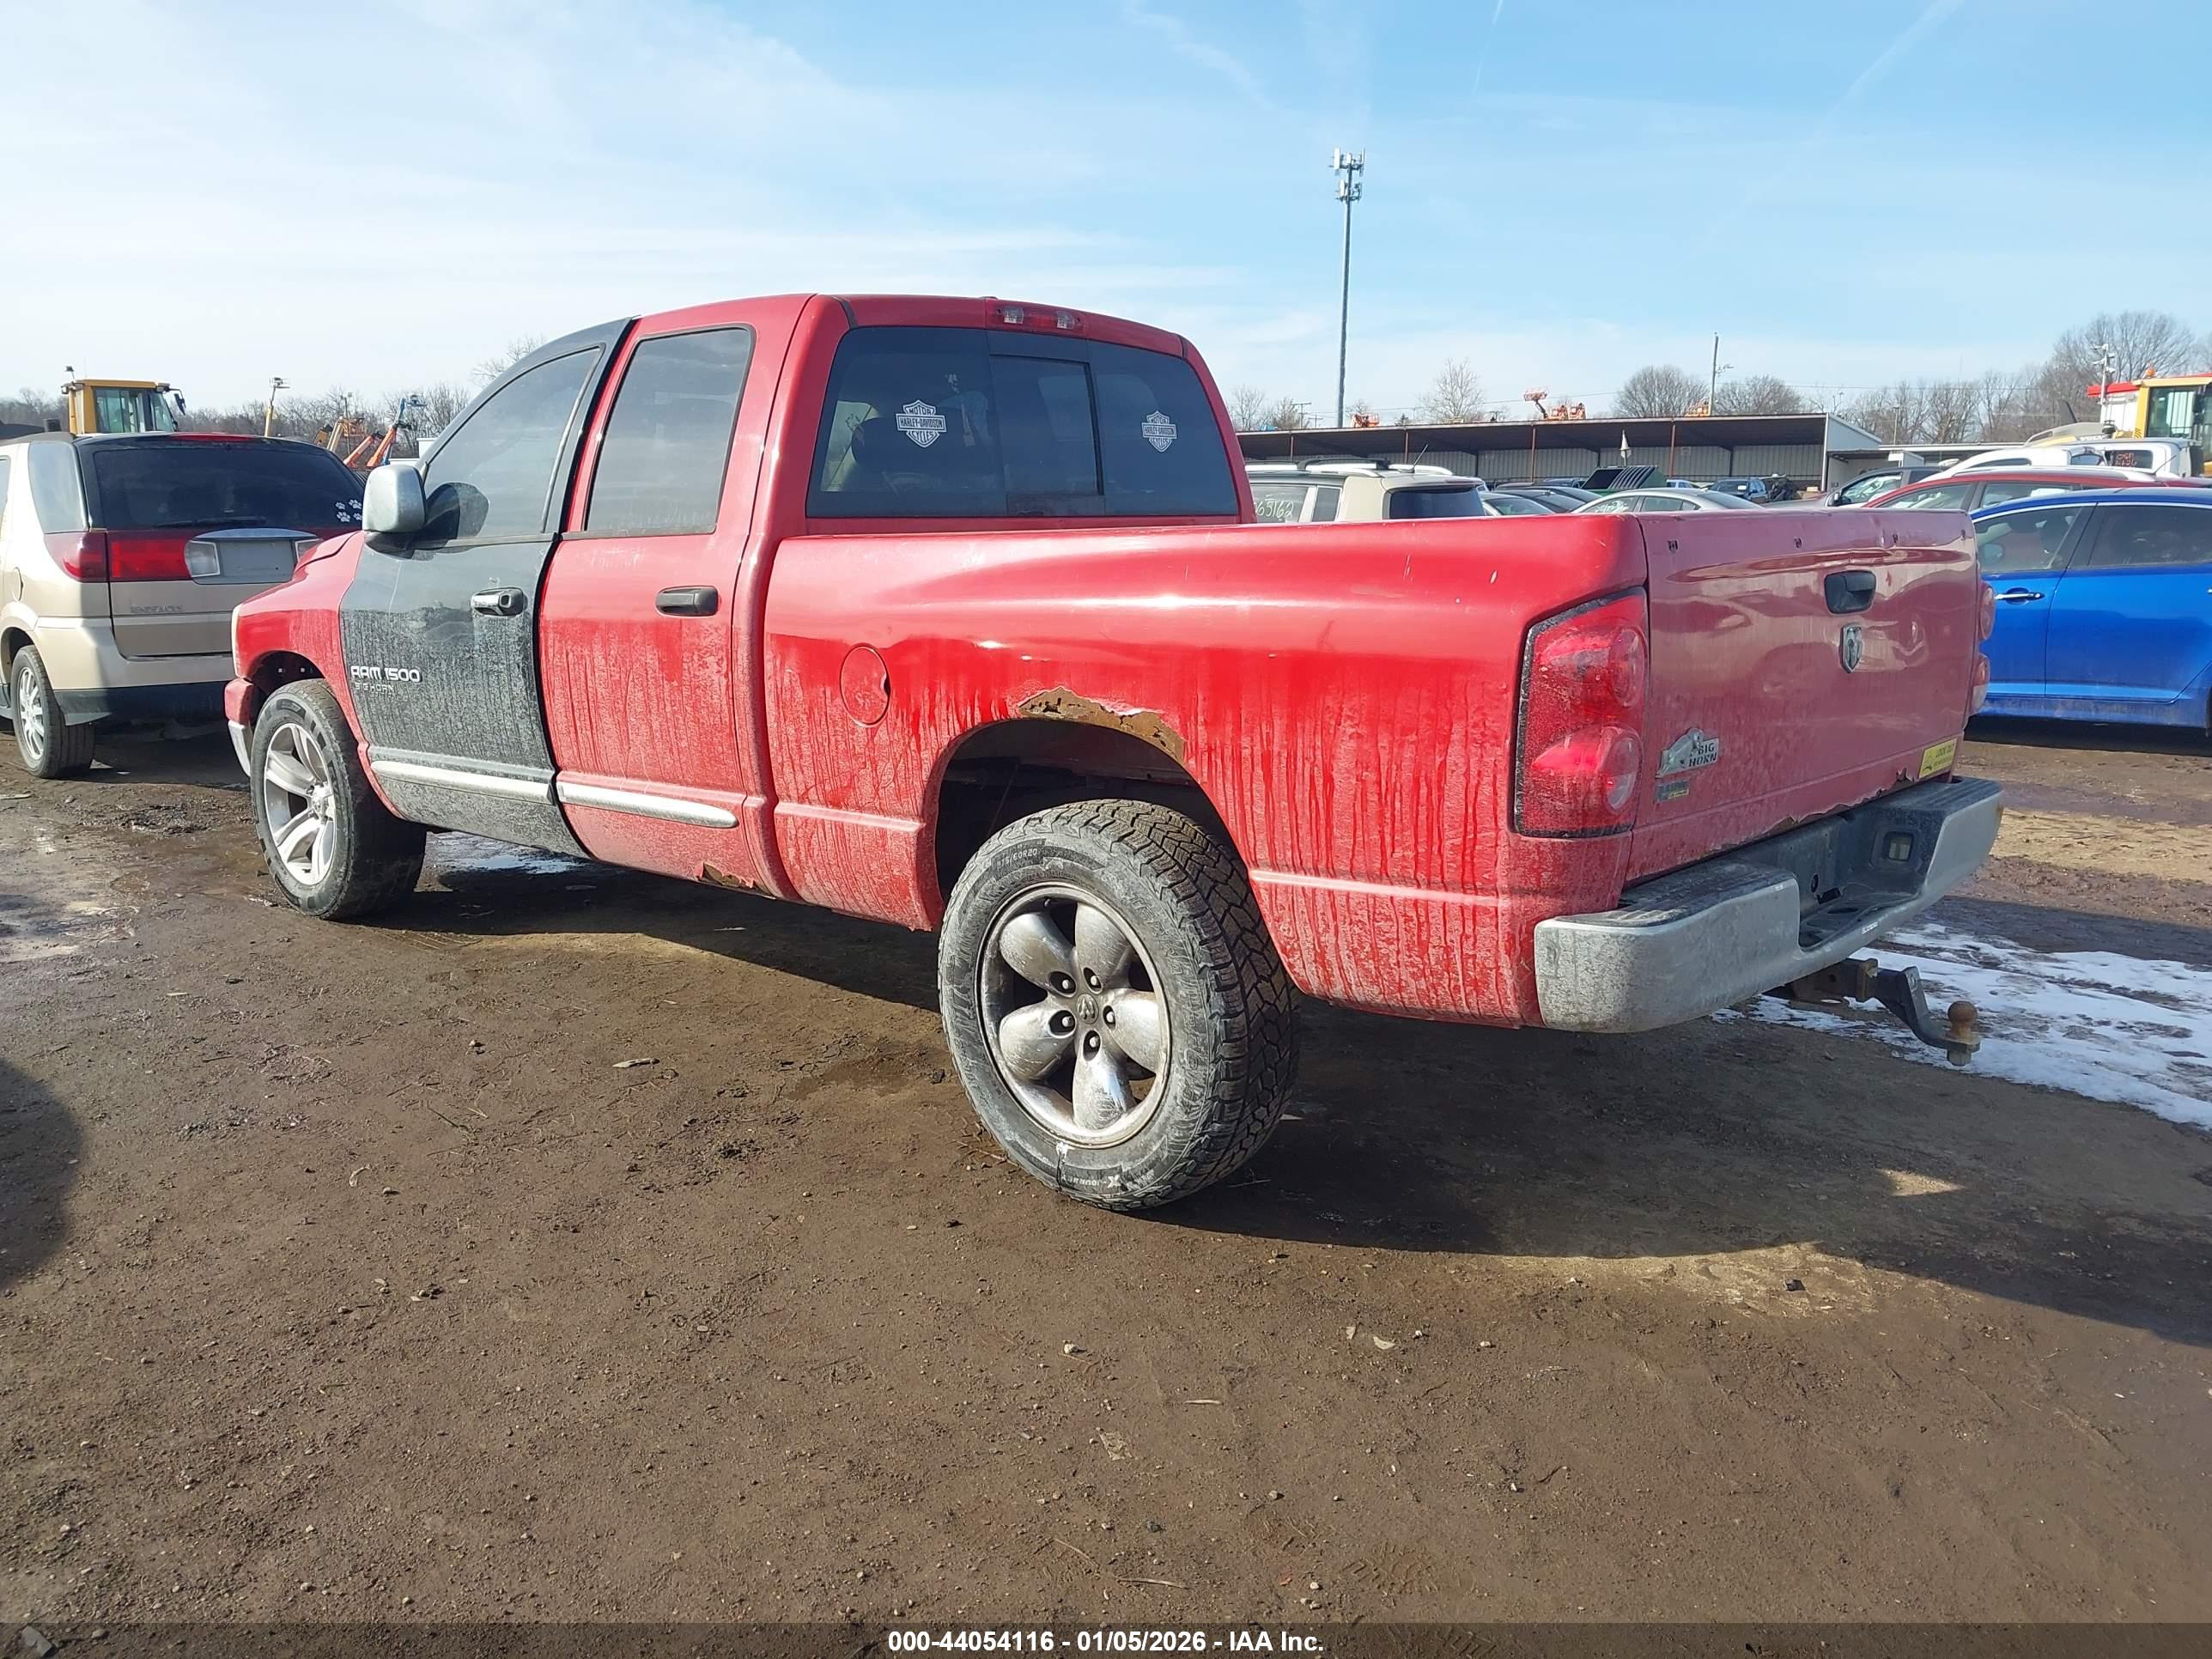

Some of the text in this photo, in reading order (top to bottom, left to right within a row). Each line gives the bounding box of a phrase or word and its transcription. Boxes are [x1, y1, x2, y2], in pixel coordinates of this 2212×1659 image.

[907, 406, 933, 416] MOTOR
[899, 417, 943, 428] HARLEY-DAVIDSON
[909, 430, 937, 443] CYCLES
[350, 665, 421, 683] RAM 1500
[1698, 742, 1715, 756] BIG
[1688, 752, 1717, 768] HORN
